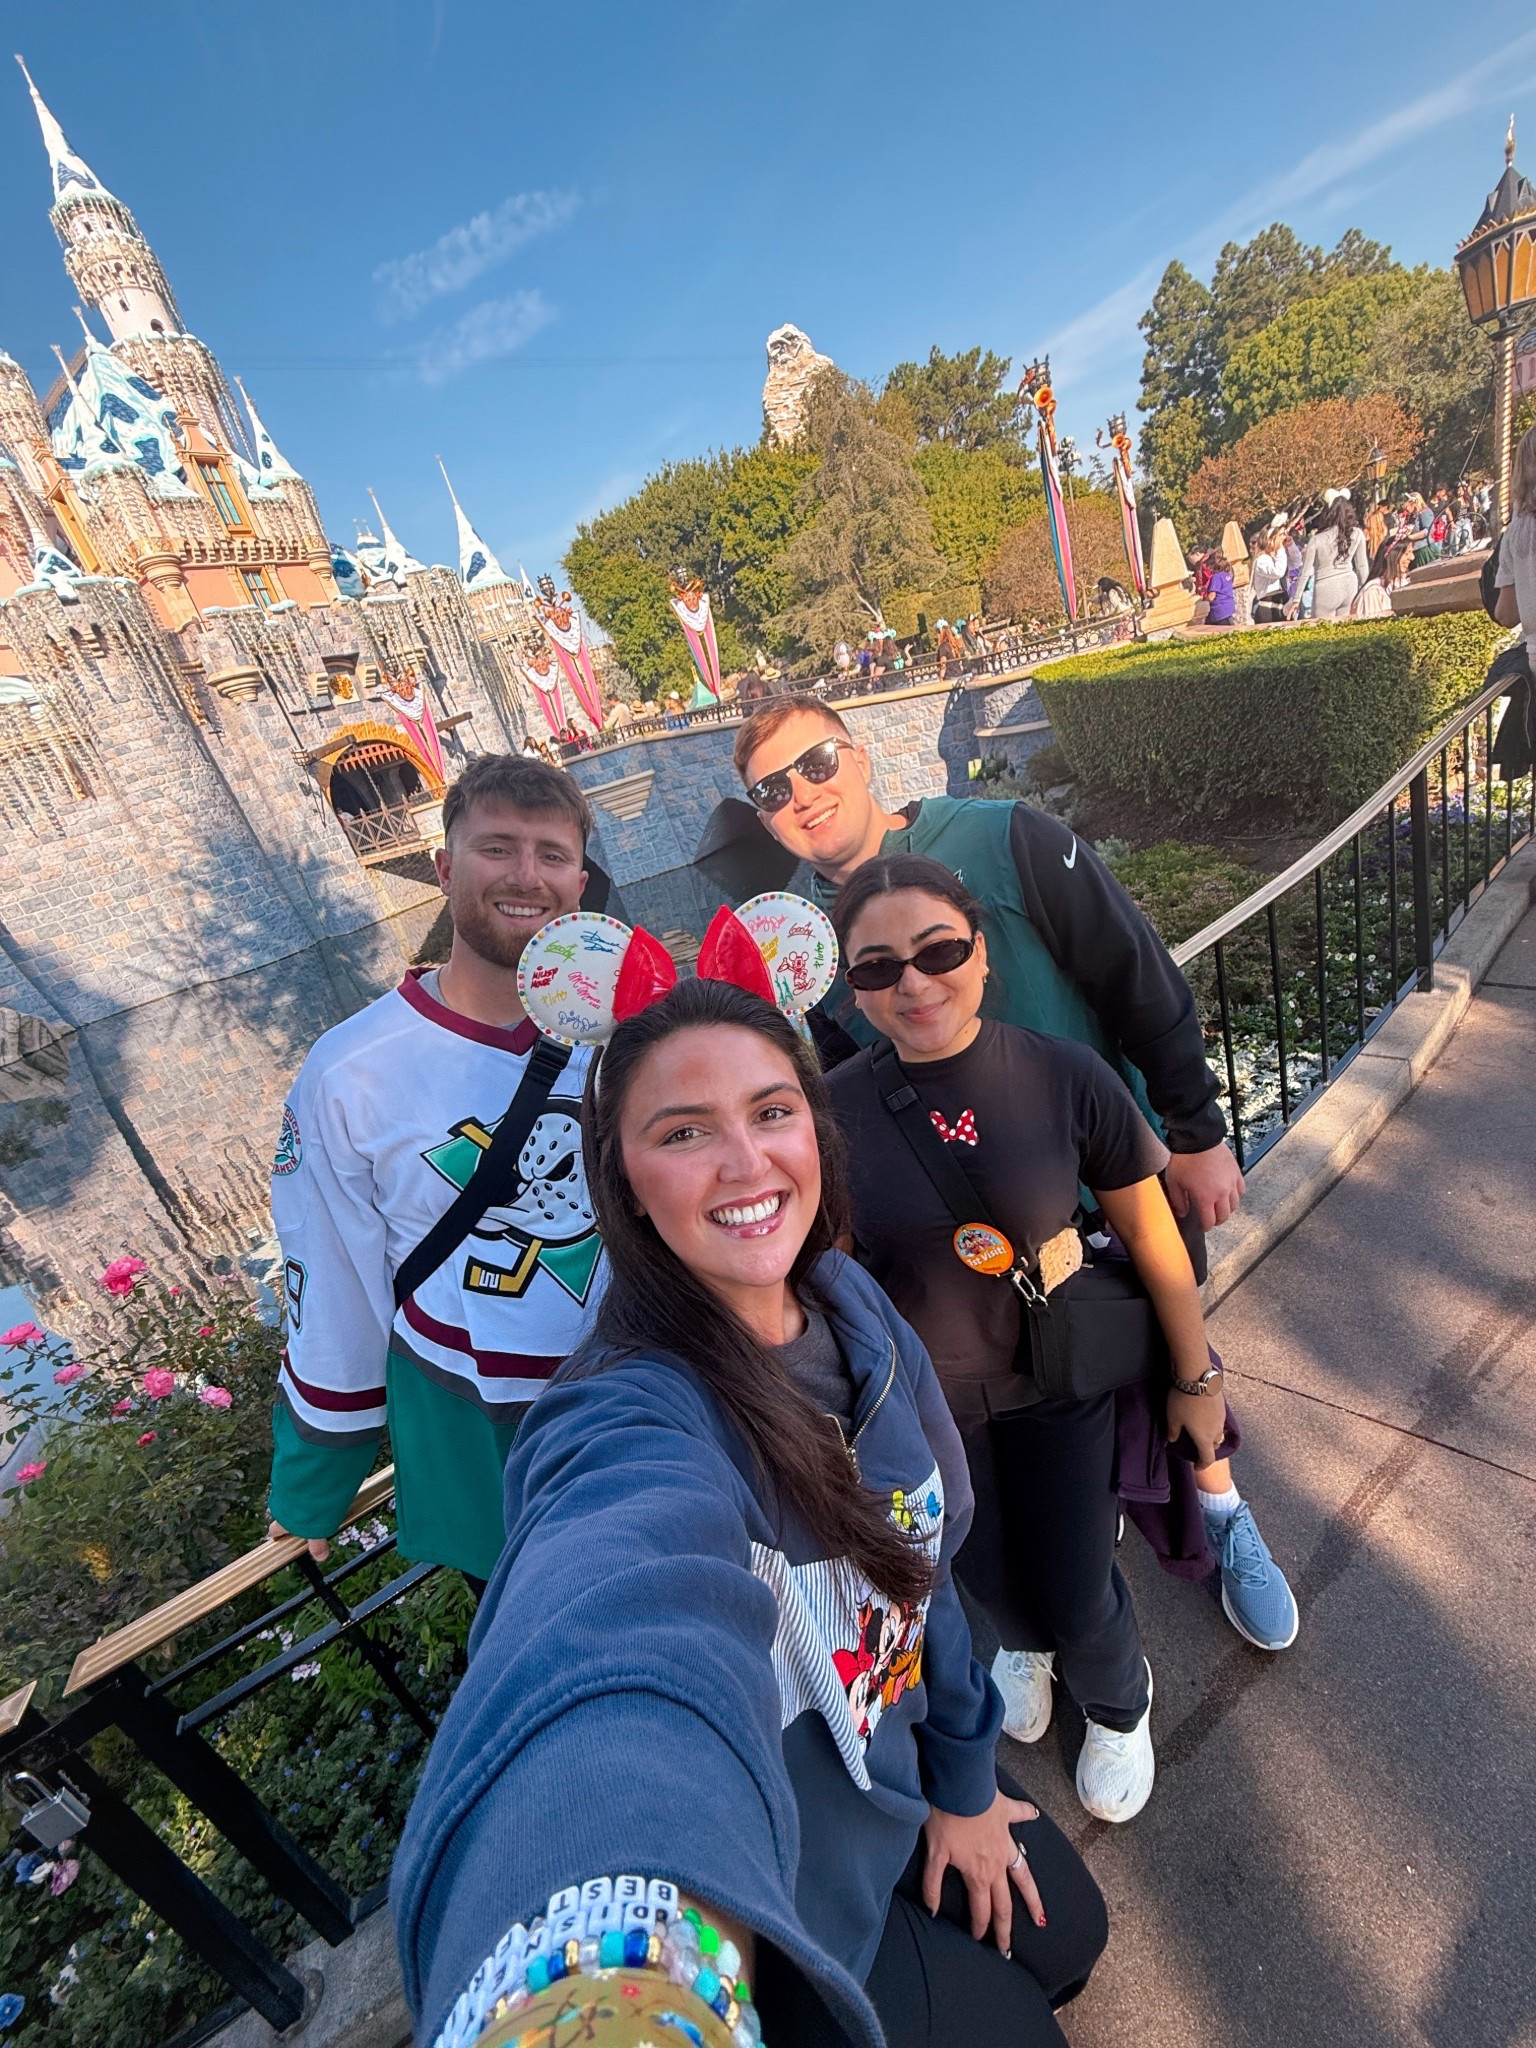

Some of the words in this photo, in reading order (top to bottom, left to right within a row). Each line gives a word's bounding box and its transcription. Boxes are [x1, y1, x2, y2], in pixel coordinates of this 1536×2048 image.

[284, 1108, 302, 1145] DUCKS
[967, 1258, 983, 1267] 1st
[553, 1878, 672, 1915] BEST
